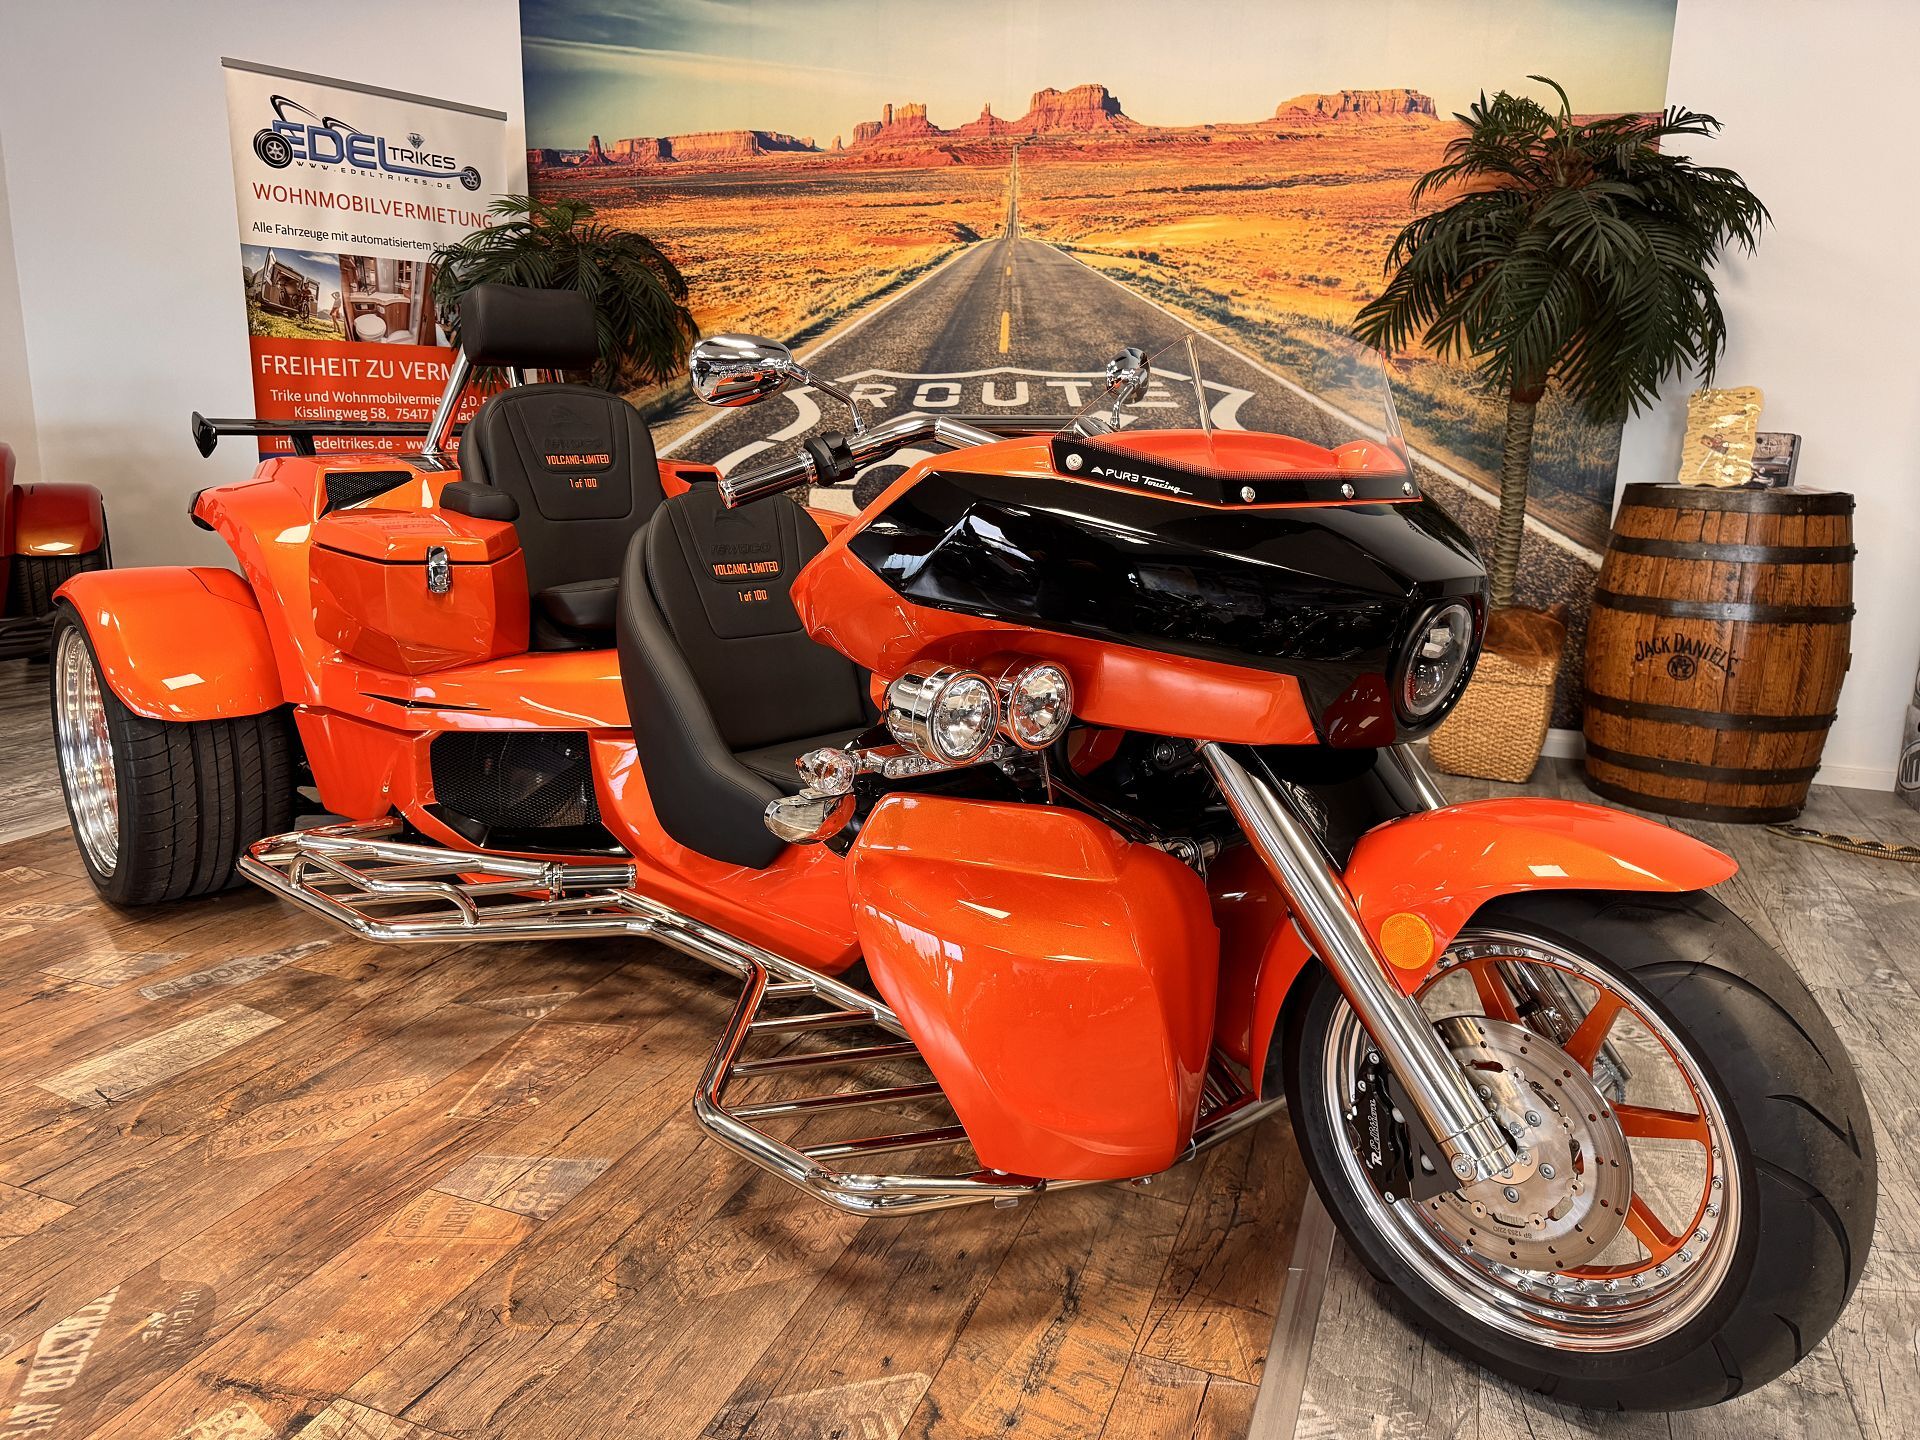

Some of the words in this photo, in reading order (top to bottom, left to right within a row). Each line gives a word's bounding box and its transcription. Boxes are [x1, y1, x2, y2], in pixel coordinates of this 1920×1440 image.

[296, 160, 452, 190] WWW.EDELTRIKES.DE
[252, 182, 494, 230] WOHNMOBILVERMIETUNG
[252, 221, 273, 234] Alle
[275, 223, 329, 242] Fahrzeuge
[331, 230, 349, 241] mit
[350, 232, 432, 251] automatisiertem
[260, 354, 361, 378] FREIHEIT
[366, 360, 395, 378] ZU
[270, 389, 301, 402] Trike
[305, 391, 329, 402] und
[843, 381, 1180, 408] ROUTE
[294, 406, 368, 421] Kisslingweg
[395, 408, 429, 420] 75417
[545, 453, 610, 465] VOLCANO-LIMITED
[569, 478, 574, 488] 1
[574, 479, 583, 488] of
[584, 478, 597, 488] 100
[1141, 475, 1194, 494] Touring
[712, 560, 779, 576] VOLCANO-LIMITED
[738, 591, 743, 602] 1
[743, 590, 752, 602] of
[753, 589, 768, 601] 100
[1635, 636, 1671, 661] JACK
[342, 1084, 428, 1109] STREET
